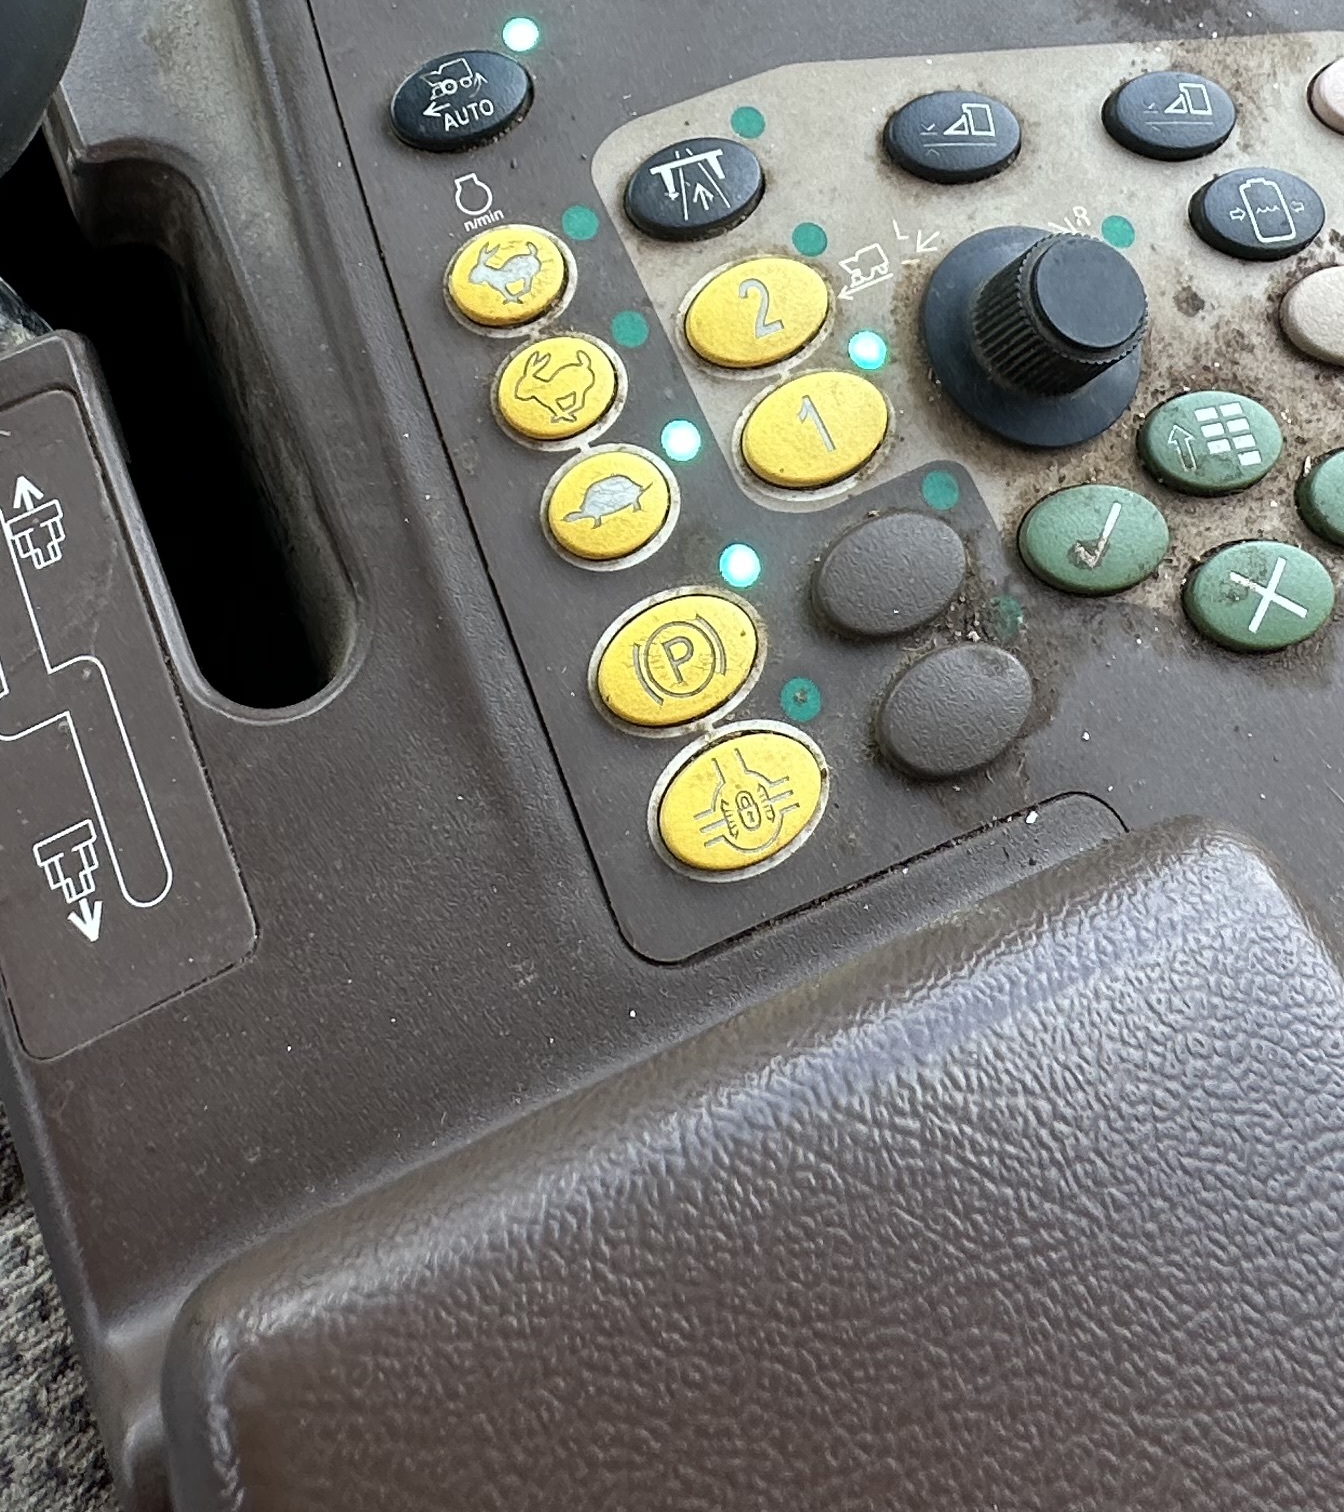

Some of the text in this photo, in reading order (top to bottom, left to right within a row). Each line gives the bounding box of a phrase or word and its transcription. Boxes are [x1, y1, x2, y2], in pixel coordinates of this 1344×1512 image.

[444, 98, 495, 132] AUTO
[463, 208, 505, 232] n/min
[738, 277, 785, 339] 2
[797, 394, 837, 454] 1
[661, 635, 695, 684] P
